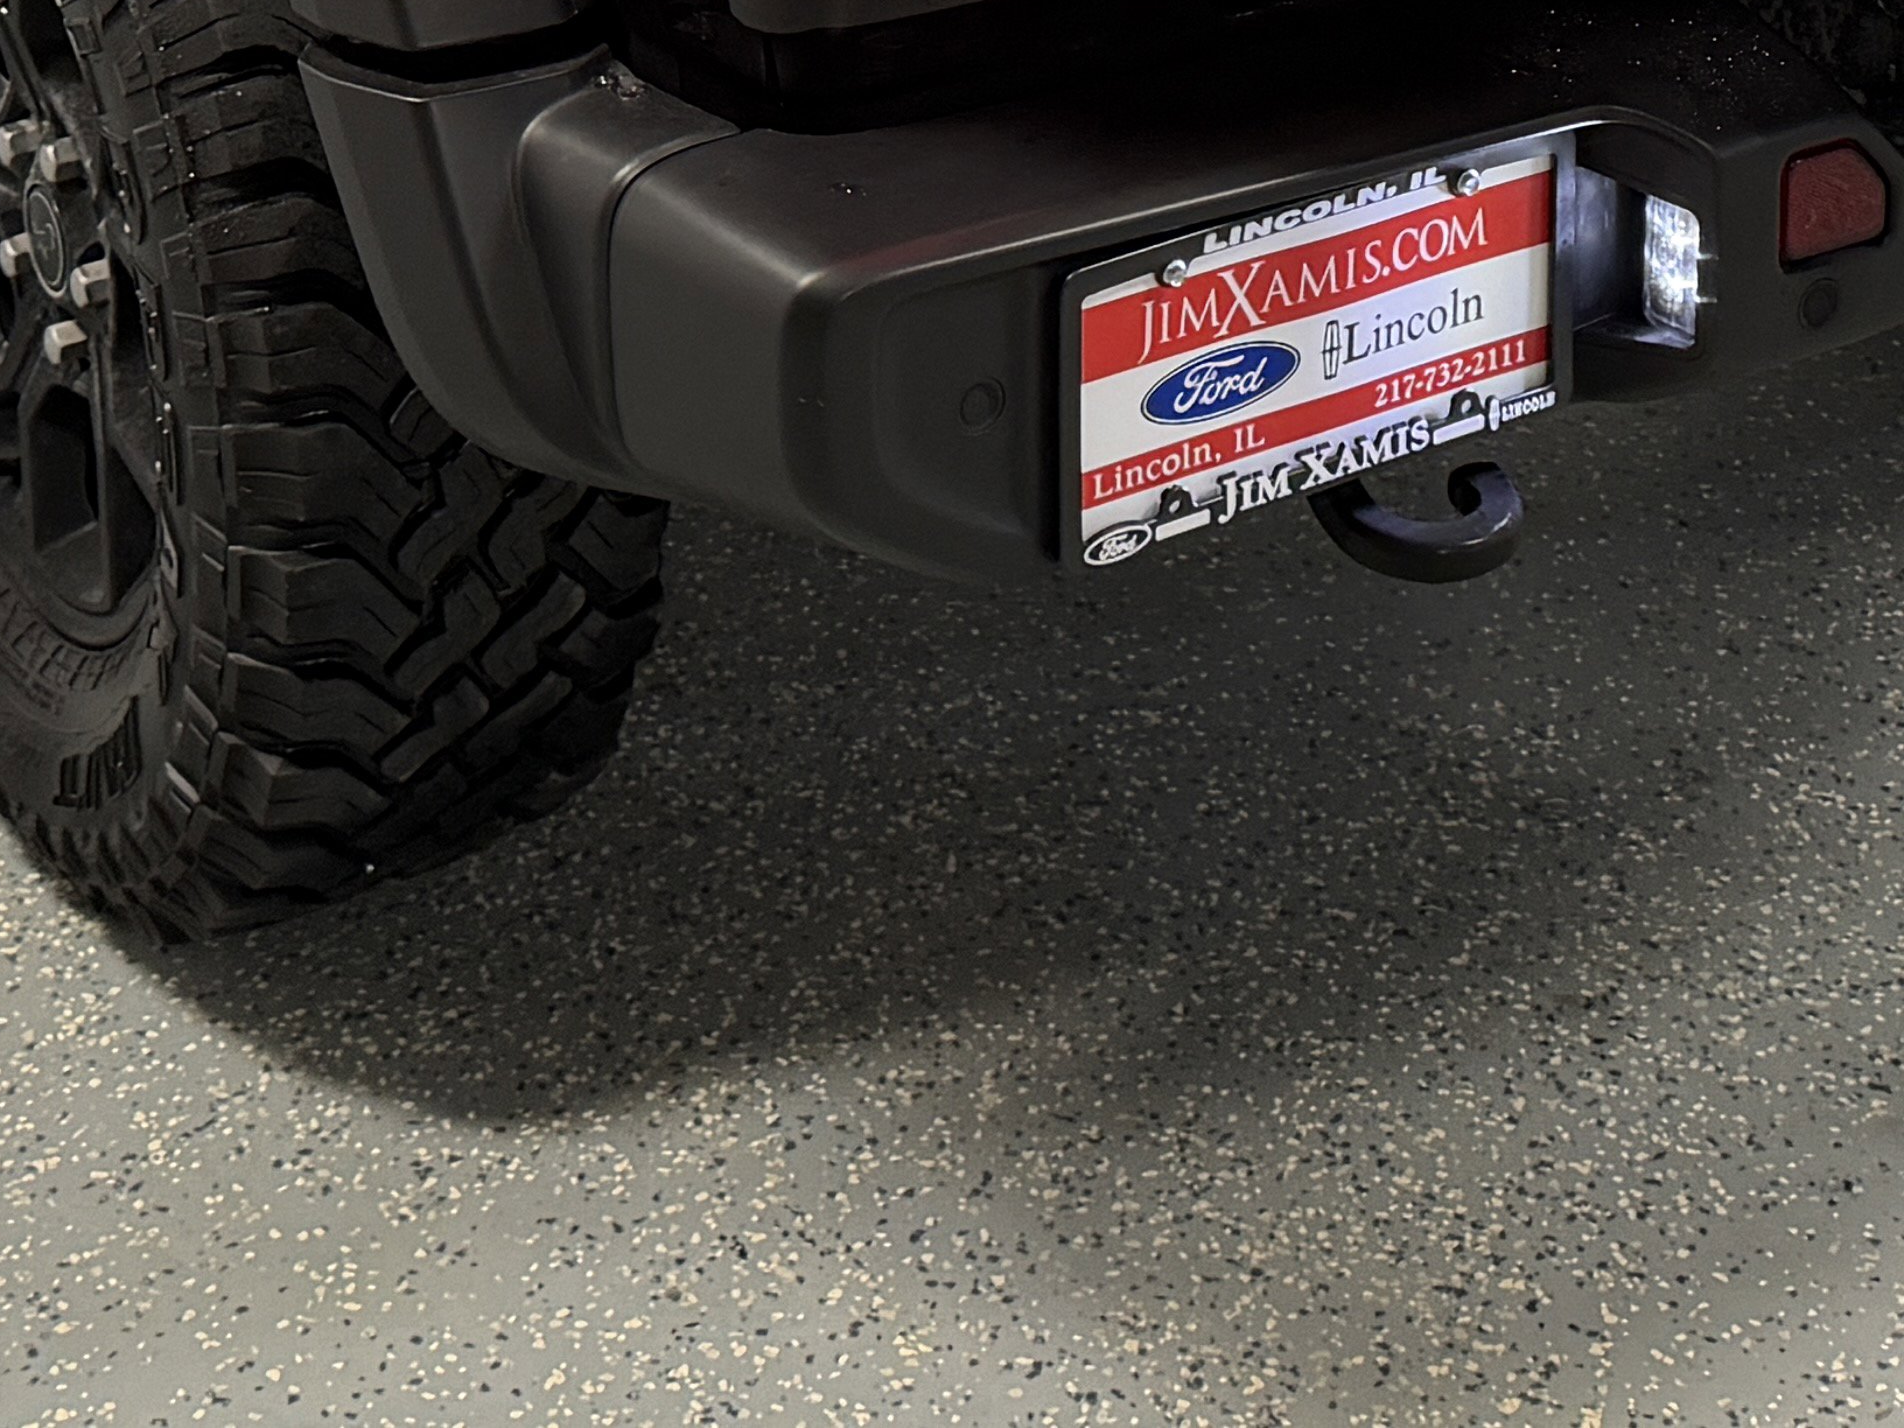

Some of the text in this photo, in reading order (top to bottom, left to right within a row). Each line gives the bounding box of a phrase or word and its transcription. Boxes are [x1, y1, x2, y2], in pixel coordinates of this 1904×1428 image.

[1203, 166, 1446, 254] LINCOLN, IL
[1342, 287, 1485, 365] Lincoln
[1173, 354, 1267, 414] Ford
[1375, 339, 1528, 408] 217-732-2111
[1093, 424, 1265, 499] Lincoln, IL
[1217, 419, 1431, 525] JIM XAMIS
[1098, 533, 1139, 562] Ford
